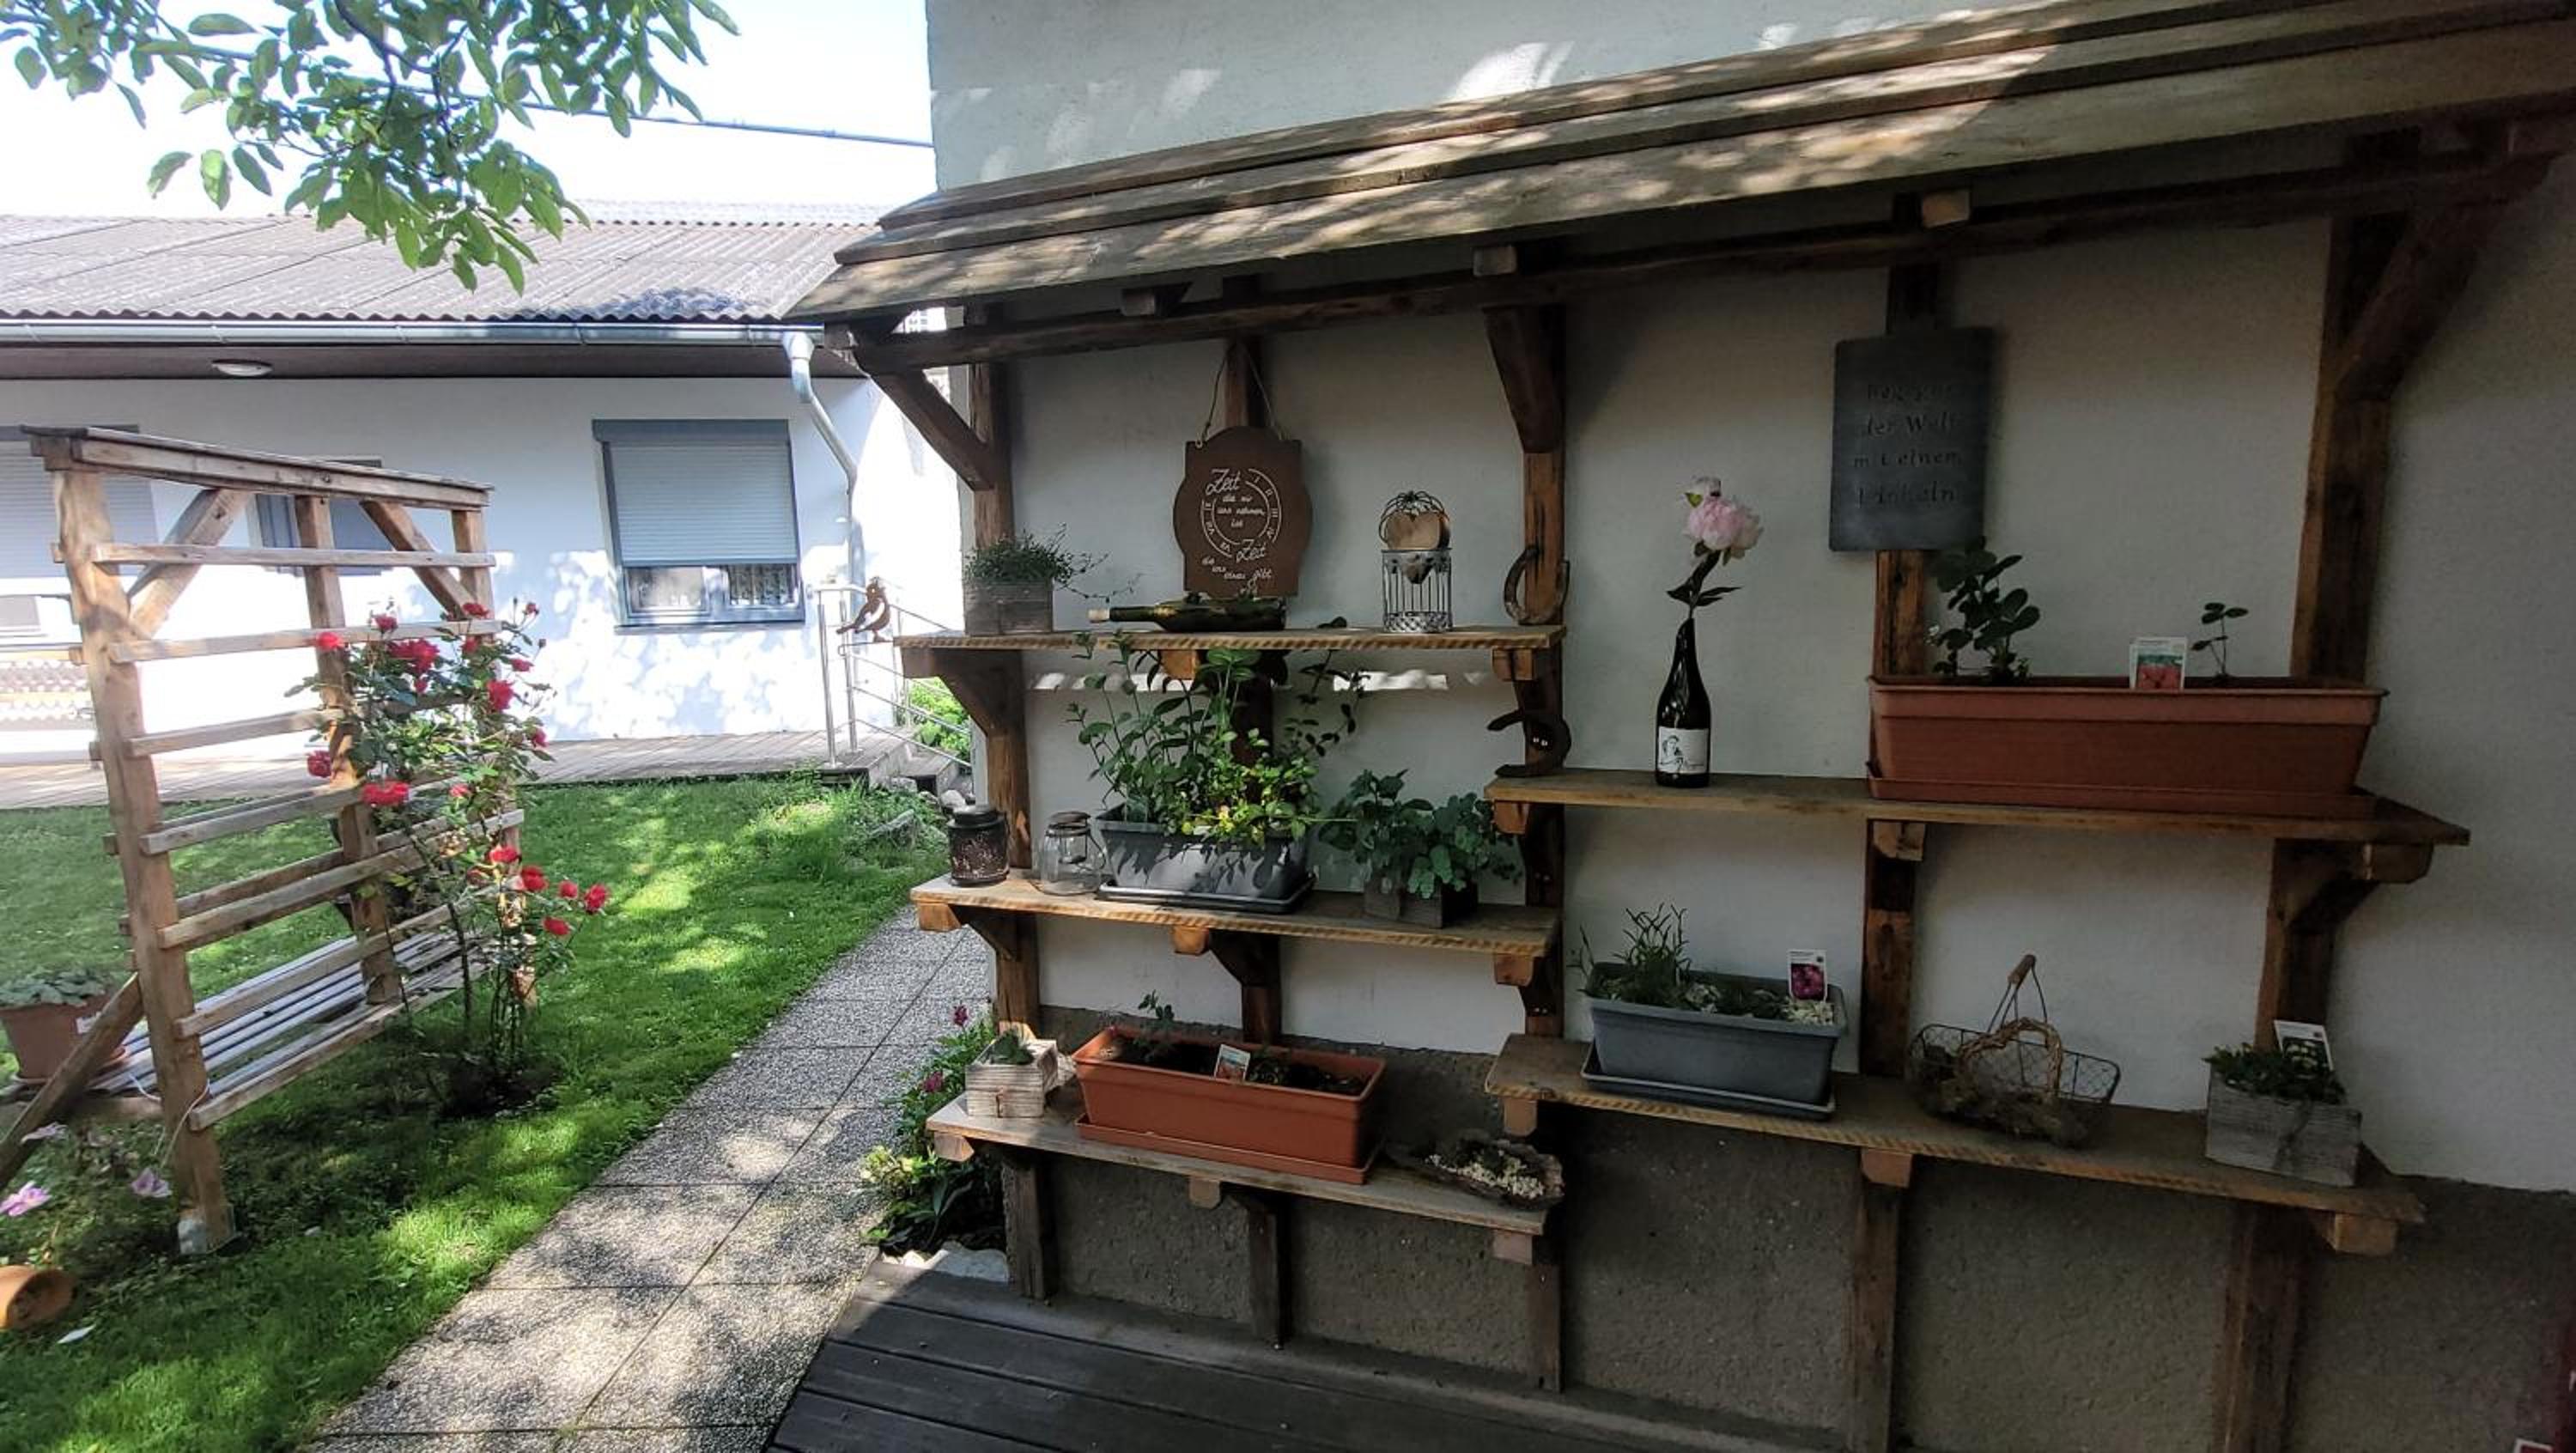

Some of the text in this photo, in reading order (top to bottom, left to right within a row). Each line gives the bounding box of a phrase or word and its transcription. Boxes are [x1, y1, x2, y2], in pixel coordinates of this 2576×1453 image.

[1854, 451, 1890, 467] mt
[1206, 468, 1240, 495] Zeit
[1236, 538, 1267, 563] Zeit
